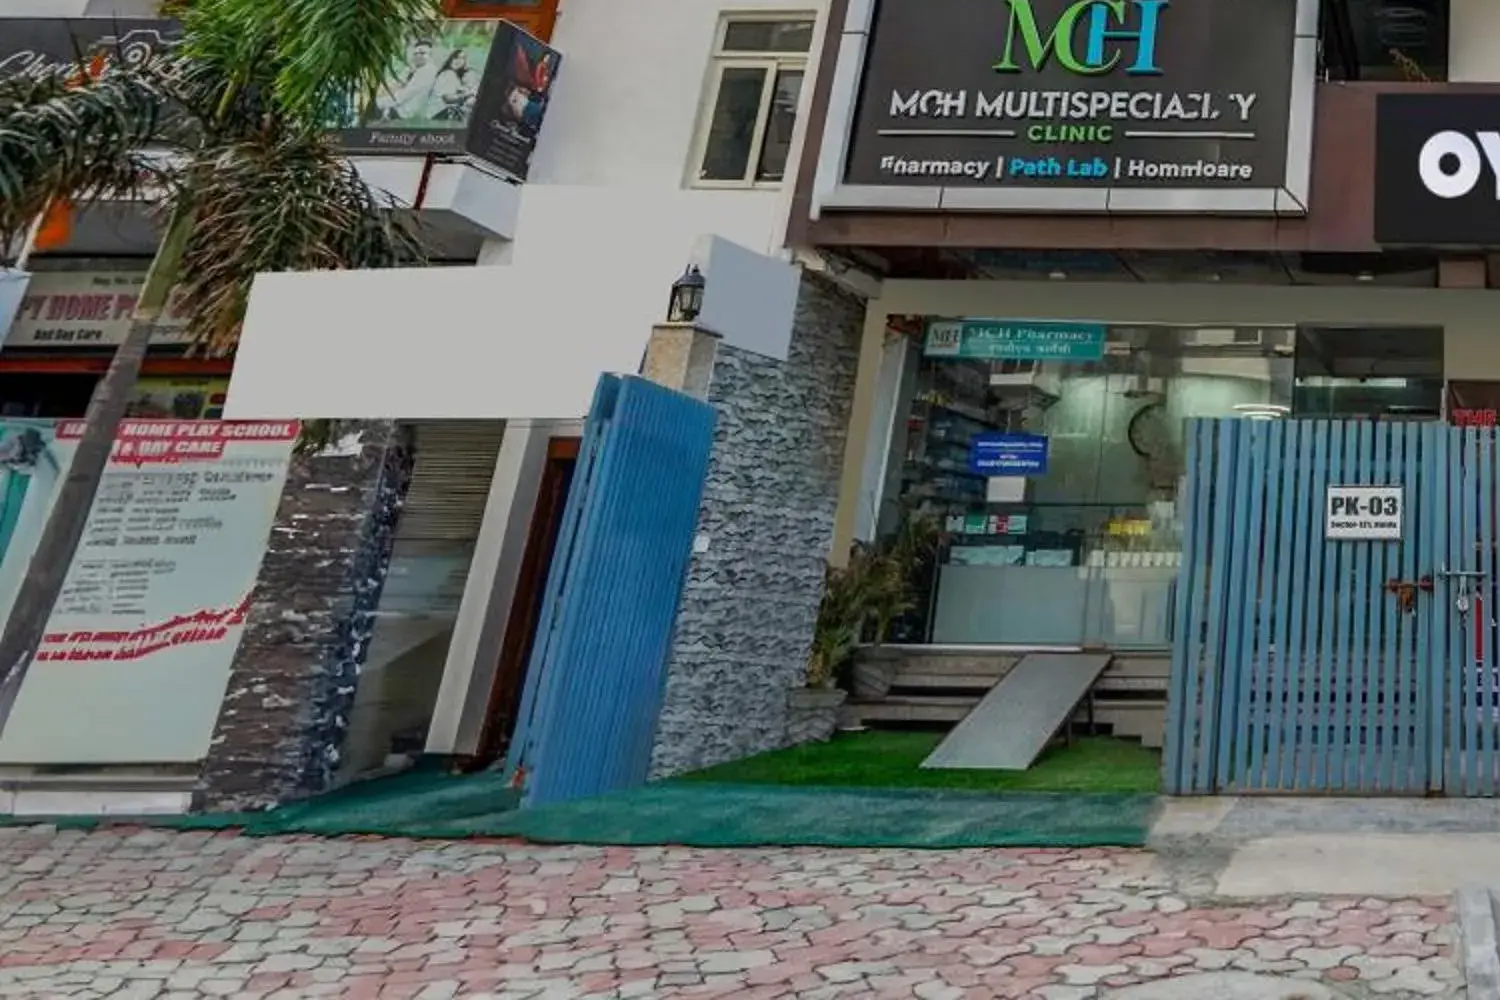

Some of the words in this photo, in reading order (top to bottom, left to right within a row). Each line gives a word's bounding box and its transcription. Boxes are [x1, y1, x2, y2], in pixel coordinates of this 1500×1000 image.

[1027, 124, 1114, 143] CLINIC
[1009, 156, 1062, 177] Path
[1067, 157, 1109, 178] Lab
[175, 424, 219, 436] PLAY
[221, 424, 291, 436] SCHOOL
[1331, 496, 1398, 516] PK-03
